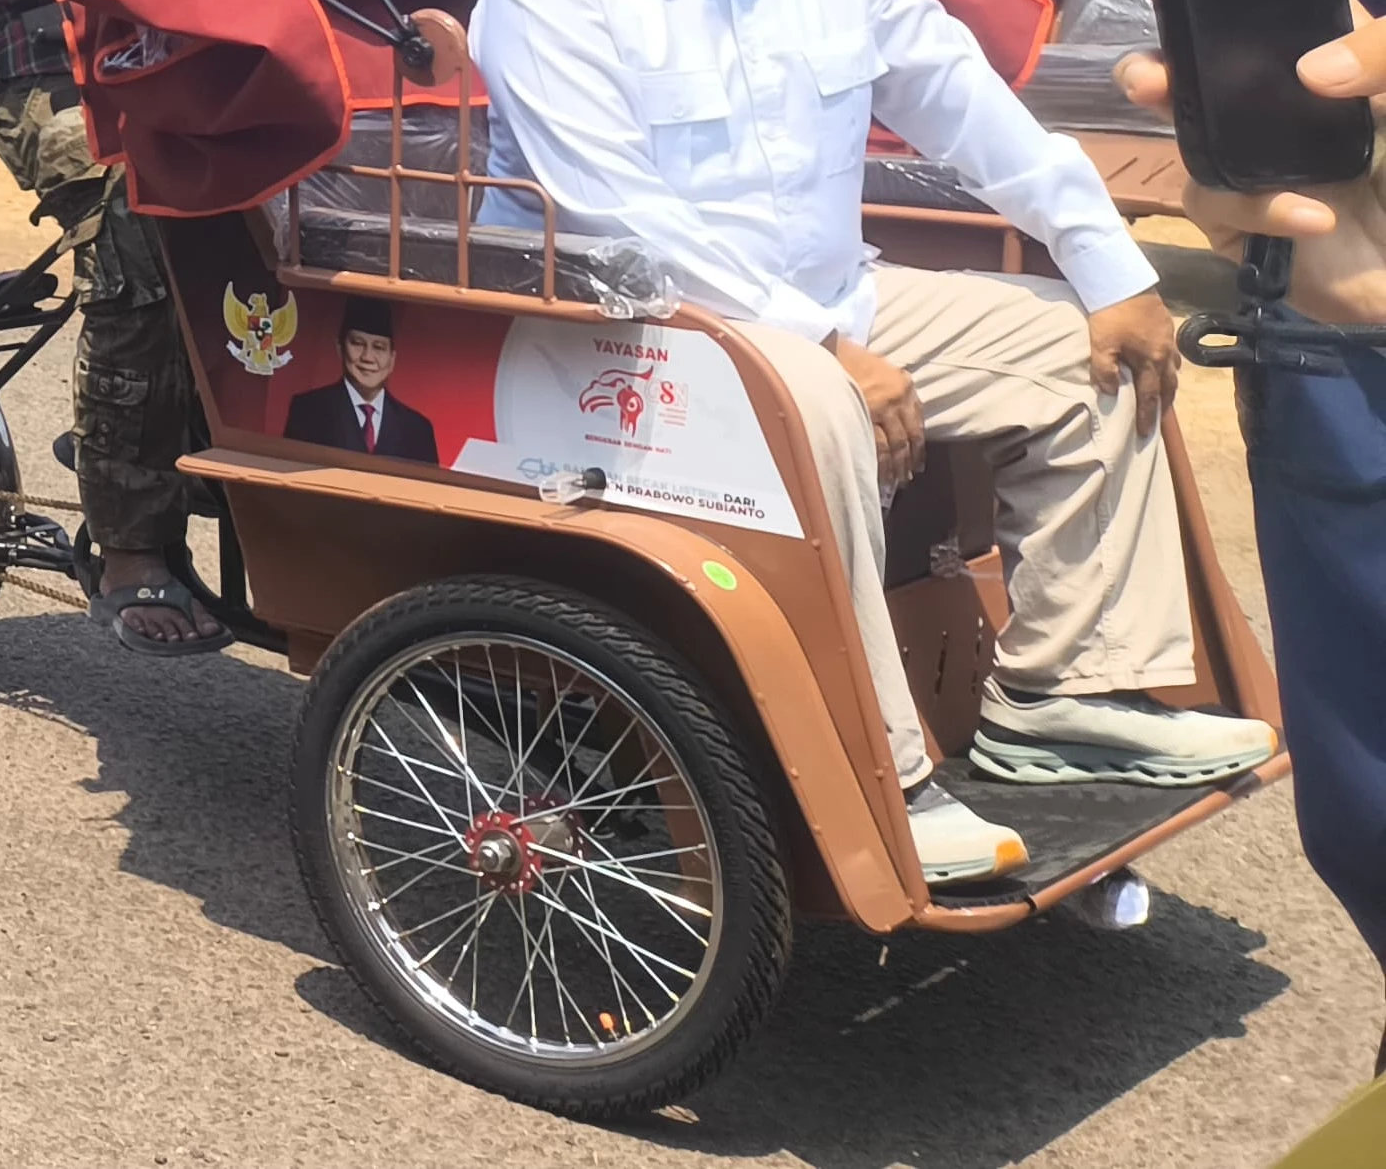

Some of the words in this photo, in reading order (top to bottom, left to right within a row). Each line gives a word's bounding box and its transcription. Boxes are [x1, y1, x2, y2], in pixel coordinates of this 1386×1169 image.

[593, 338, 668, 362] YAYASAN
[627, 485, 695, 506] PRABOWO
[698, 498, 765, 520] SUBIANTO
[723, 492, 756, 508] DARI
